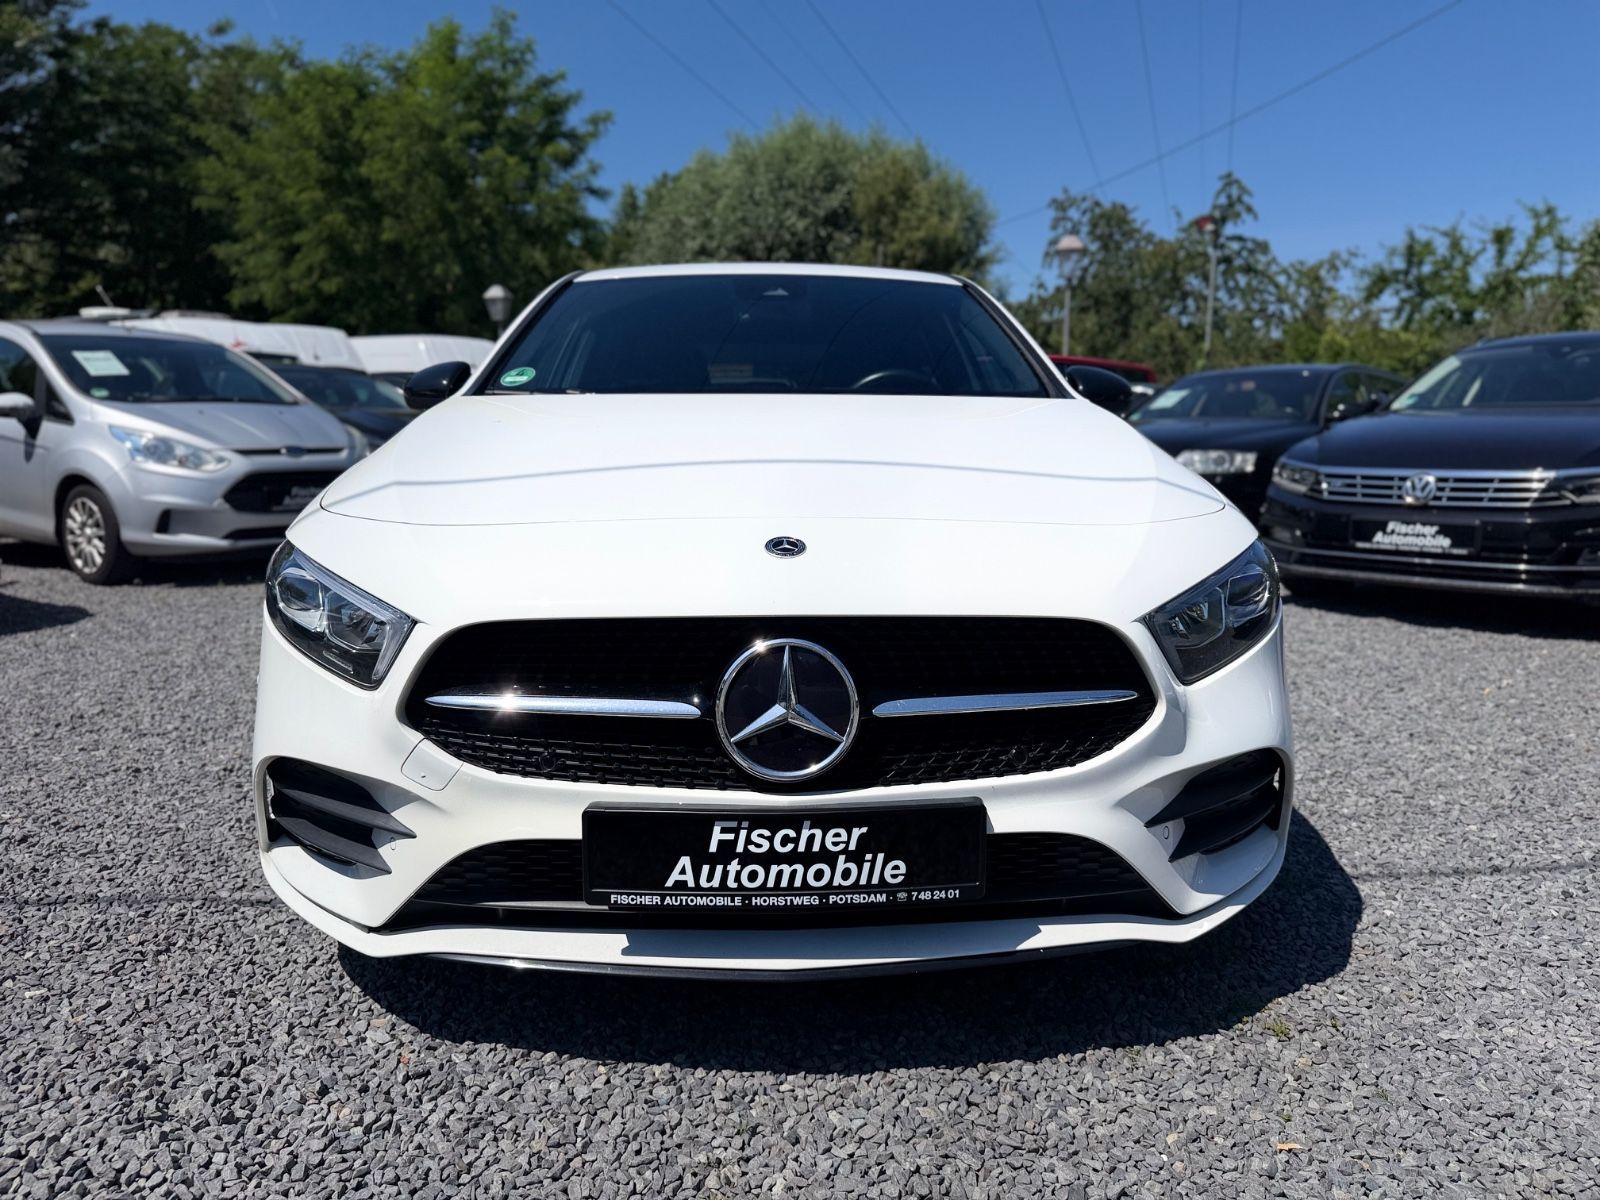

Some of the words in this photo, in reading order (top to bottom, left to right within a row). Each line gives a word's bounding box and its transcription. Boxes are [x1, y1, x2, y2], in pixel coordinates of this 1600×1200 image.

[1386, 521, 1439, 536] Fischer
[1372, 531, 1452, 548] Automobile
[708, 820, 868, 854] Fischer
[665, 853, 907, 889] Automobile
[610, 894, 661, 905] FISCHER
[664, 896, 742, 906] AUTOMOBILE
[752, 896, 820, 906] HORSTWEG
[829, 893, 887, 904] POTSDAM
